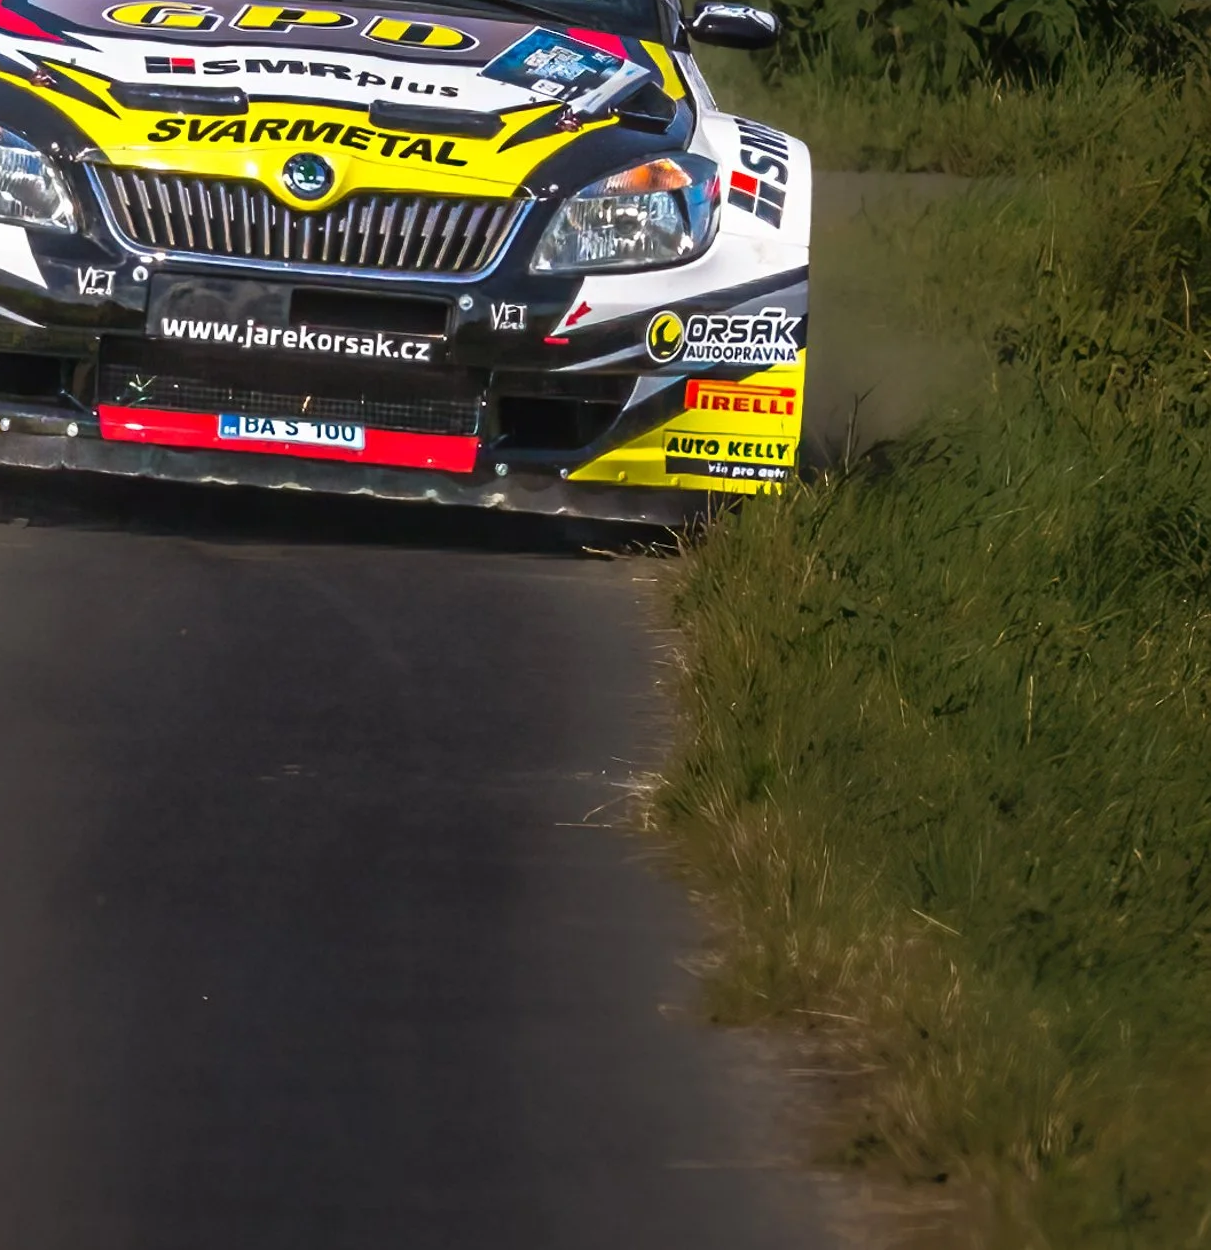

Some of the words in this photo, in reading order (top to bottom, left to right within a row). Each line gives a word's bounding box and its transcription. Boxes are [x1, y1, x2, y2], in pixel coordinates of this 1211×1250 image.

[102, 0, 480, 52] GPD
[147, 118, 469, 168] SVARMETAL
[161, 317, 430, 362] www.jarekorsak.cz
[685, 346, 797, 362] AUTOOPRAVNA
[684, 379, 797, 416] PIRELLI
[666, 437, 720, 456] AUTO
[728, 441, 790, 460] KELLY
